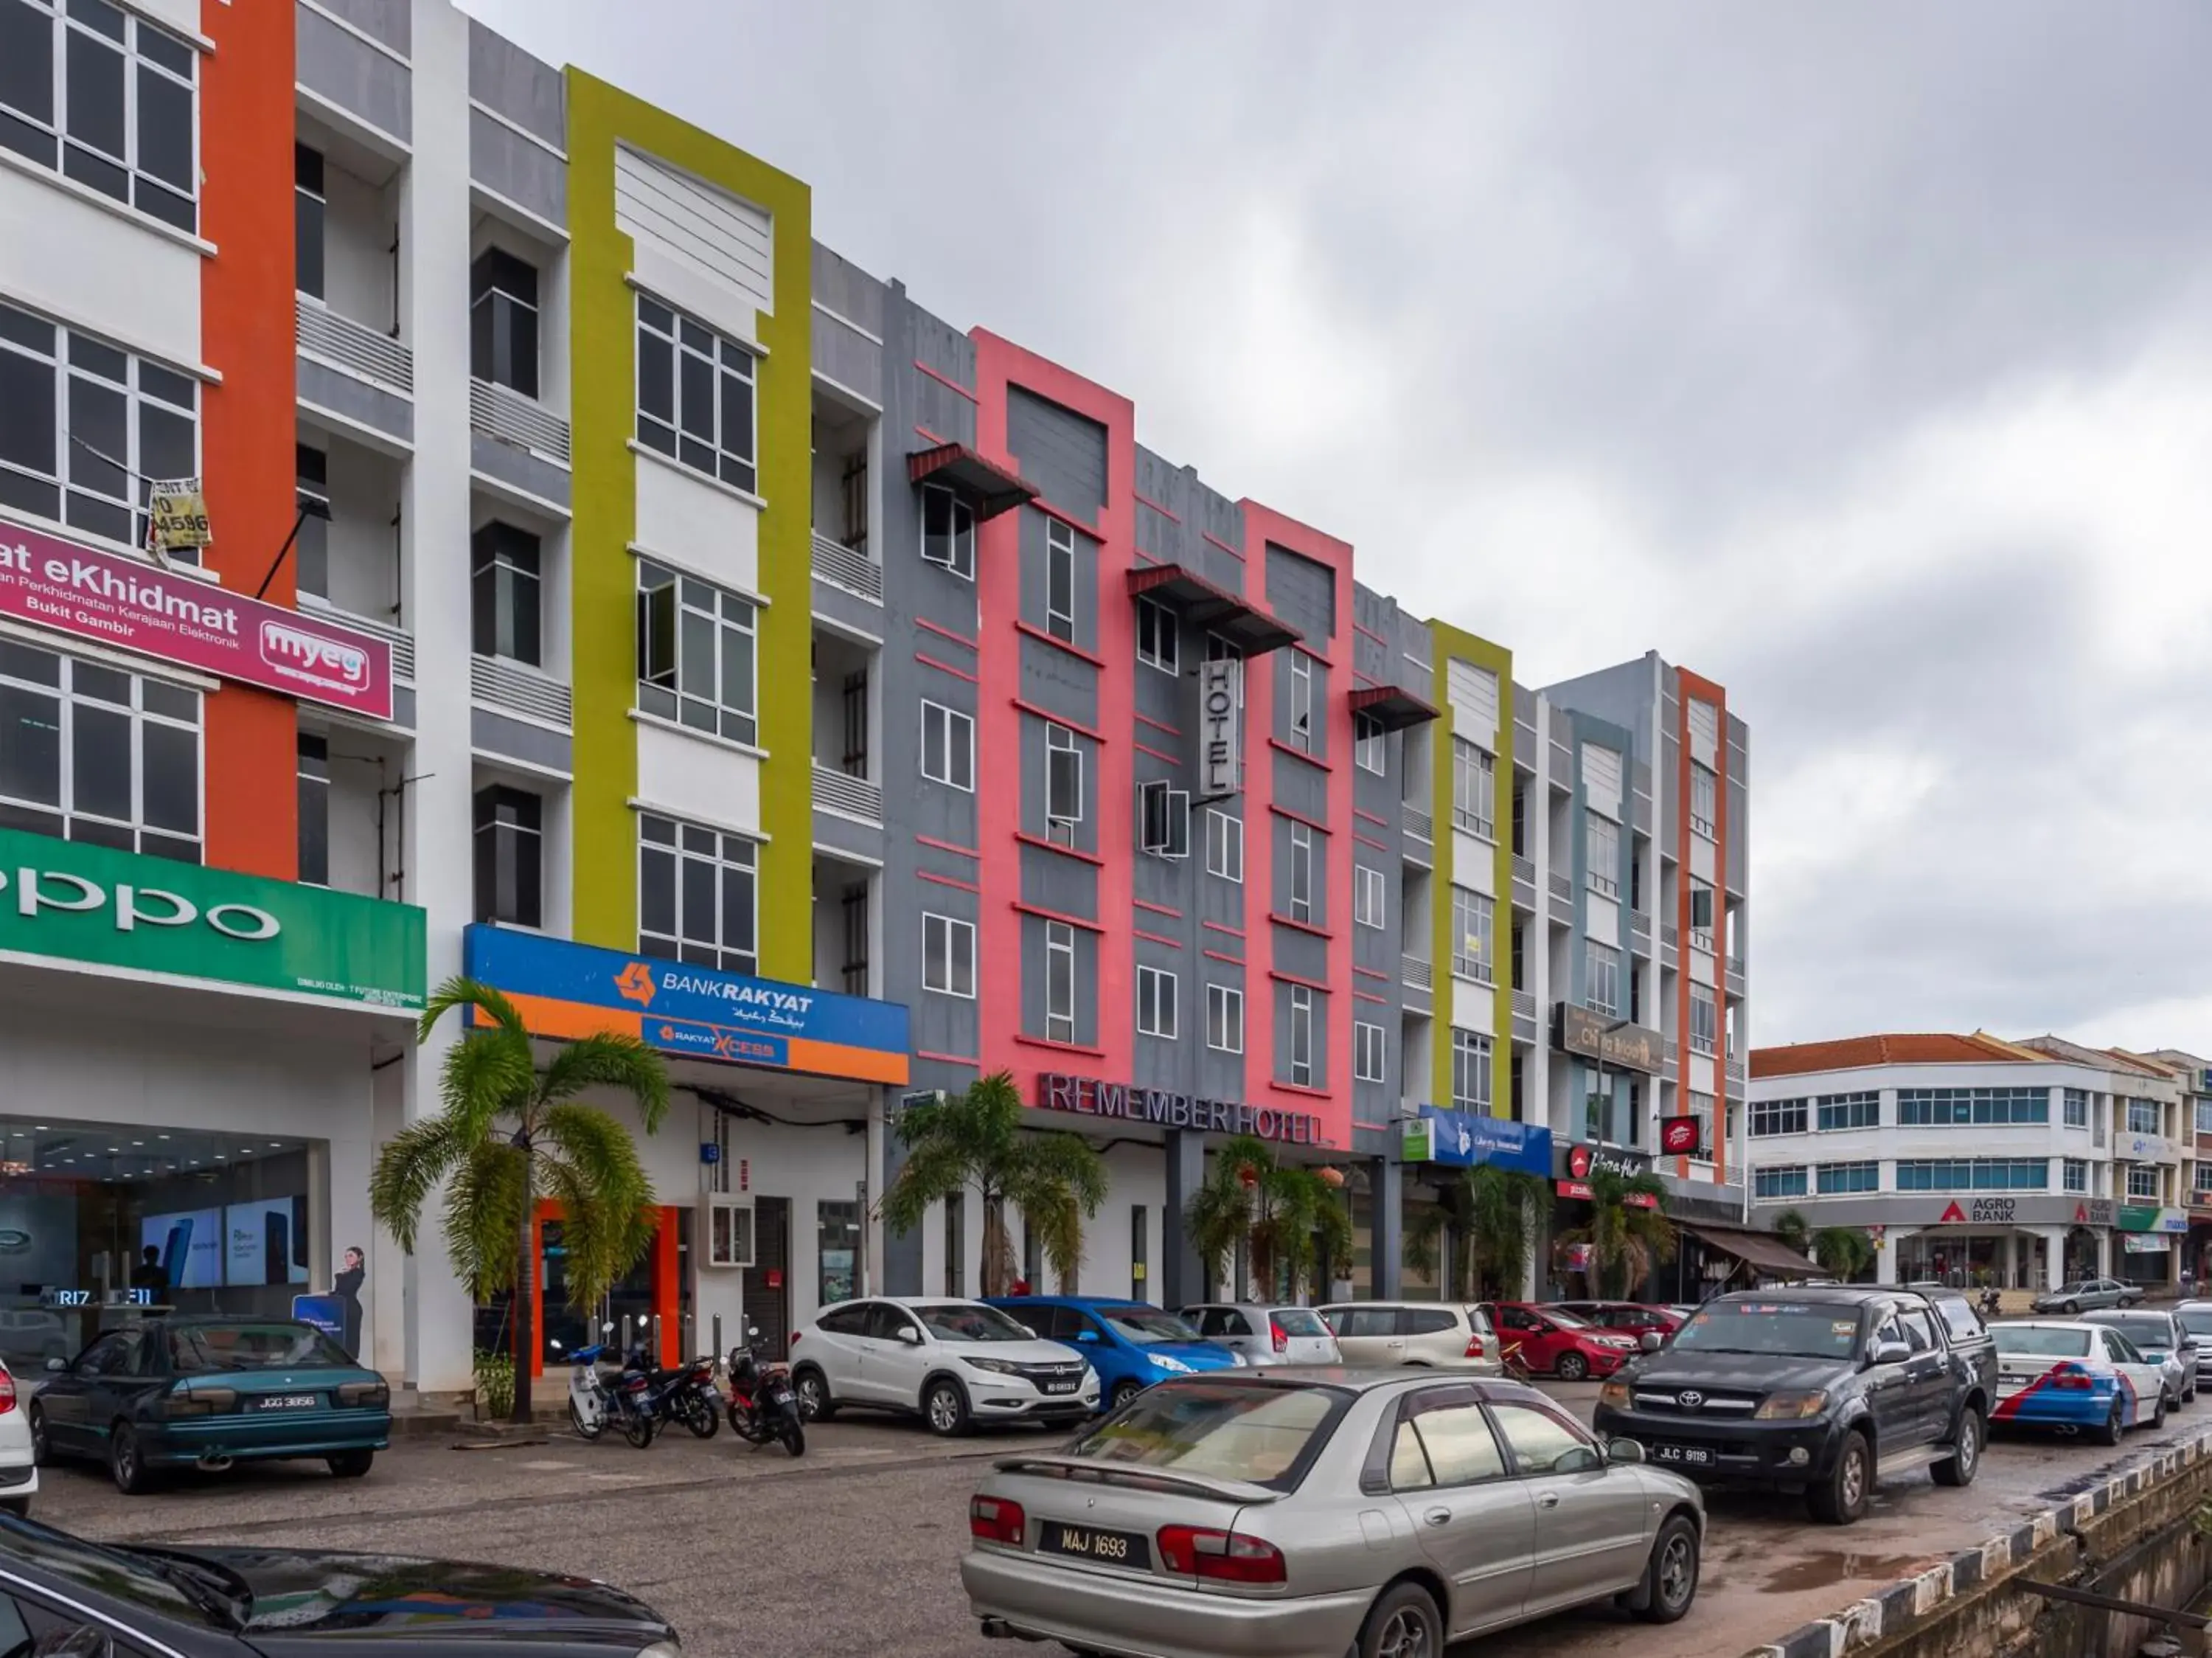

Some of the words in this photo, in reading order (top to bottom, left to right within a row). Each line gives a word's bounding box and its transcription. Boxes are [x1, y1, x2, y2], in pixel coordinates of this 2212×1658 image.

[19, 576, 114, 614] Perkhidmatan
[119, 605, 175, 632] Kerajaan
[179, 624, 240, 651] Elektronik
[26, 596, 72, 620] Bukit
[75, 610, 136, 637] Gambir
[44, 558, 239, 635] eKhidmat
[1206, 666, 1231, 788] HOTEL
[0, 867, 281, 940] ppo
[1041, 1073, 1229, 1133] REMEMBER
[1232, 1099, 1321, 1145] HOTEL
[1973, 1199, 2015, 1210] AGRO
[1973, 1210, 2014, 1221] BANK
[1660, 1448, 1680, 1460] JLC
[1686, 1449, 1707, 1463] 9119
[1062, 1529, 1090, 1552] MAJ
[1094, 1535, 1127, 1558] 1693
